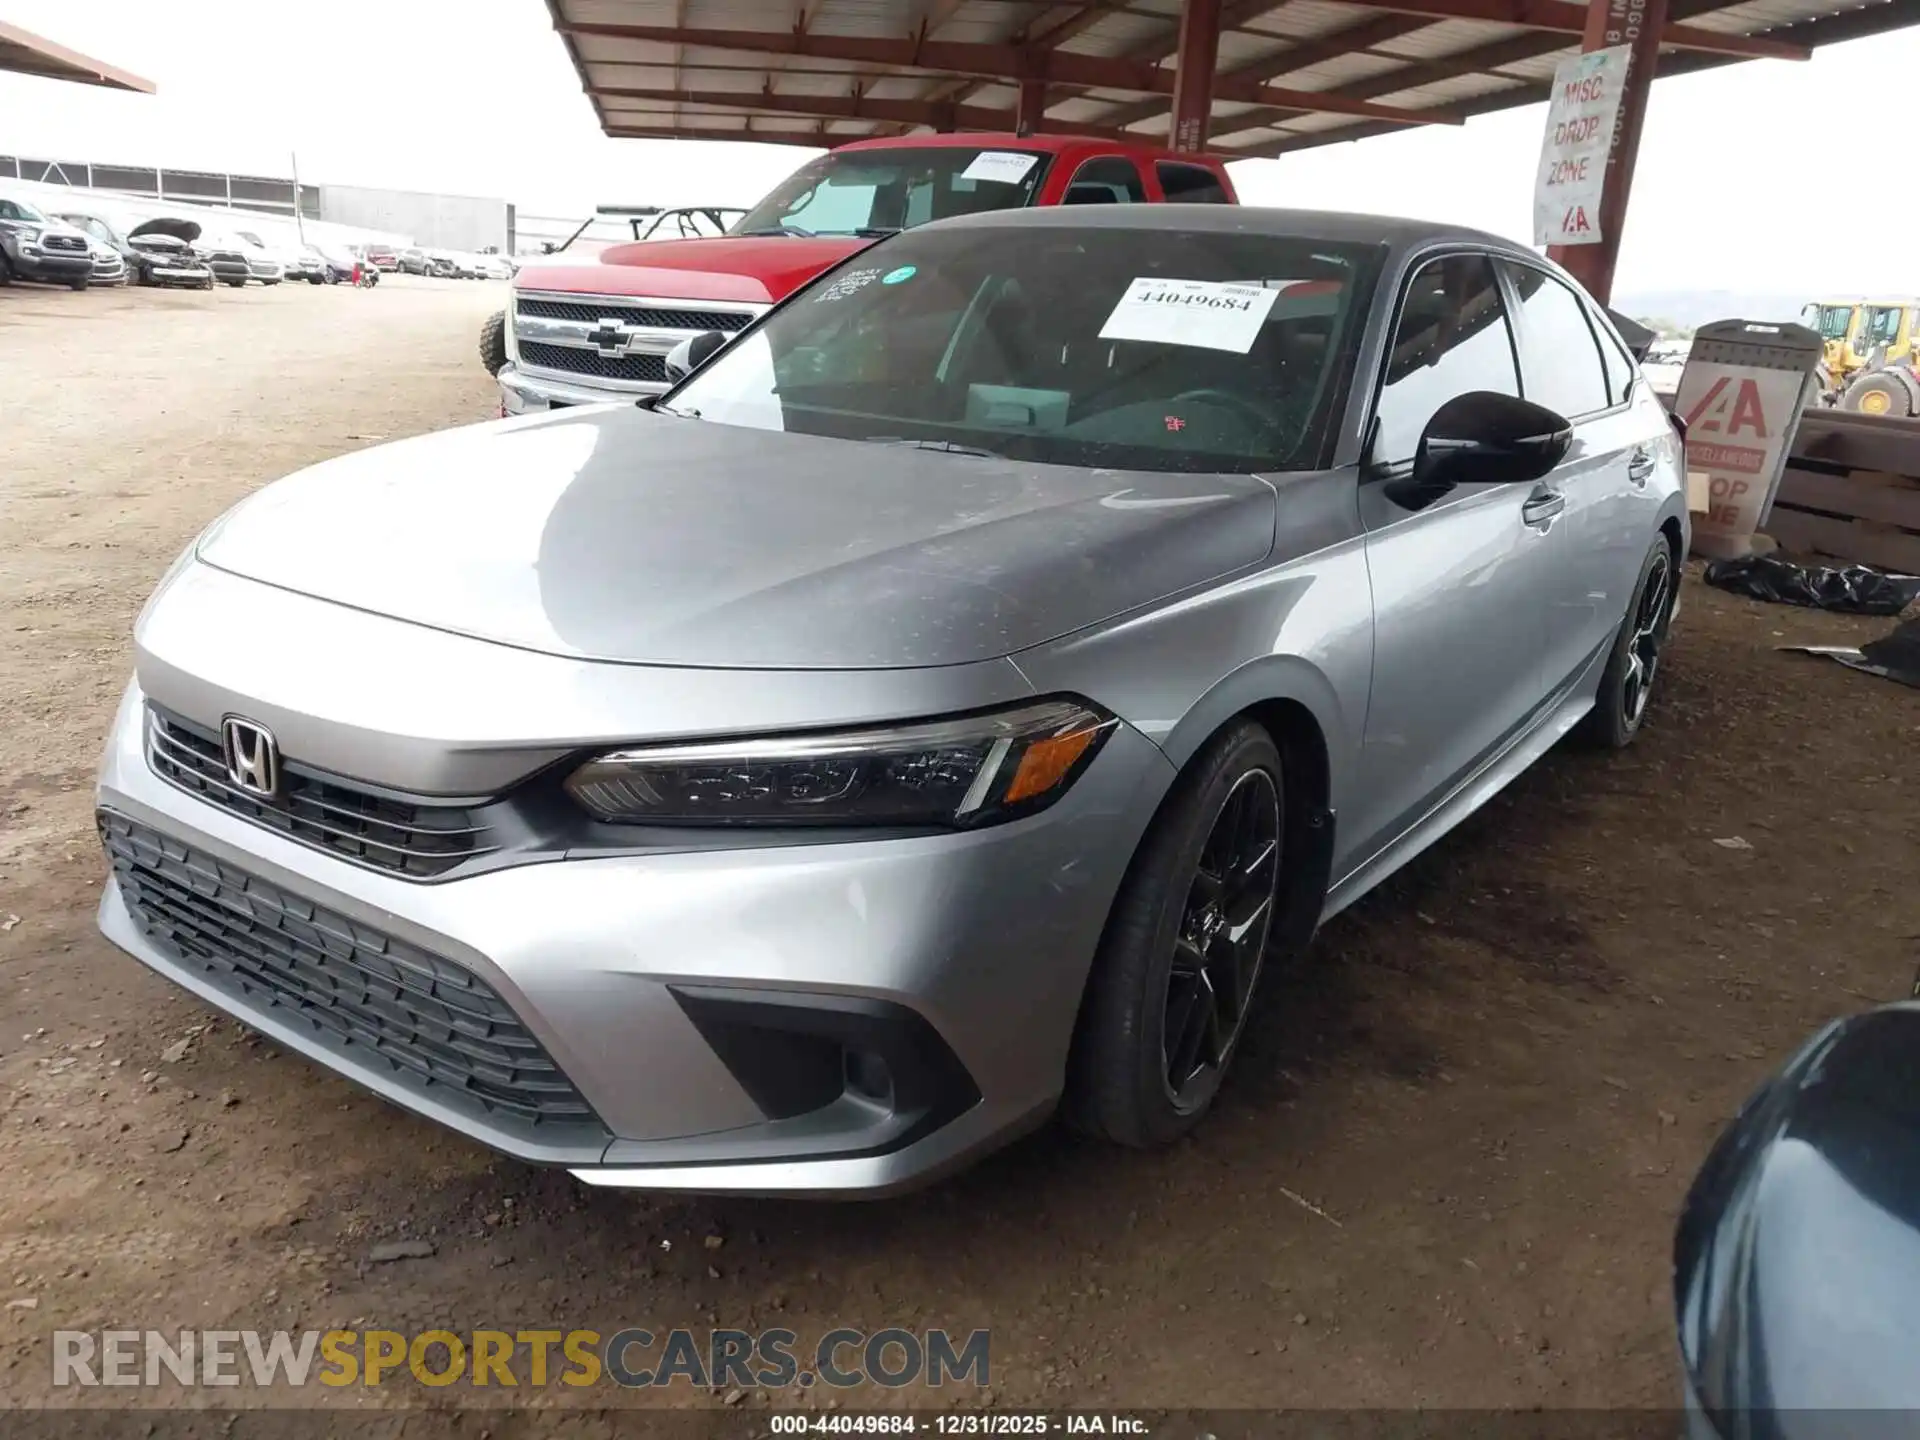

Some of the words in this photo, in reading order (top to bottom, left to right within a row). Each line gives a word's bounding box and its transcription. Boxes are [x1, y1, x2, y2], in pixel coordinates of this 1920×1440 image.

[1554, 116, 1600, 146] DROP
[1547, 157, 1591, 186] ZONE
[1138, 291, 1251, 312] 44049684
